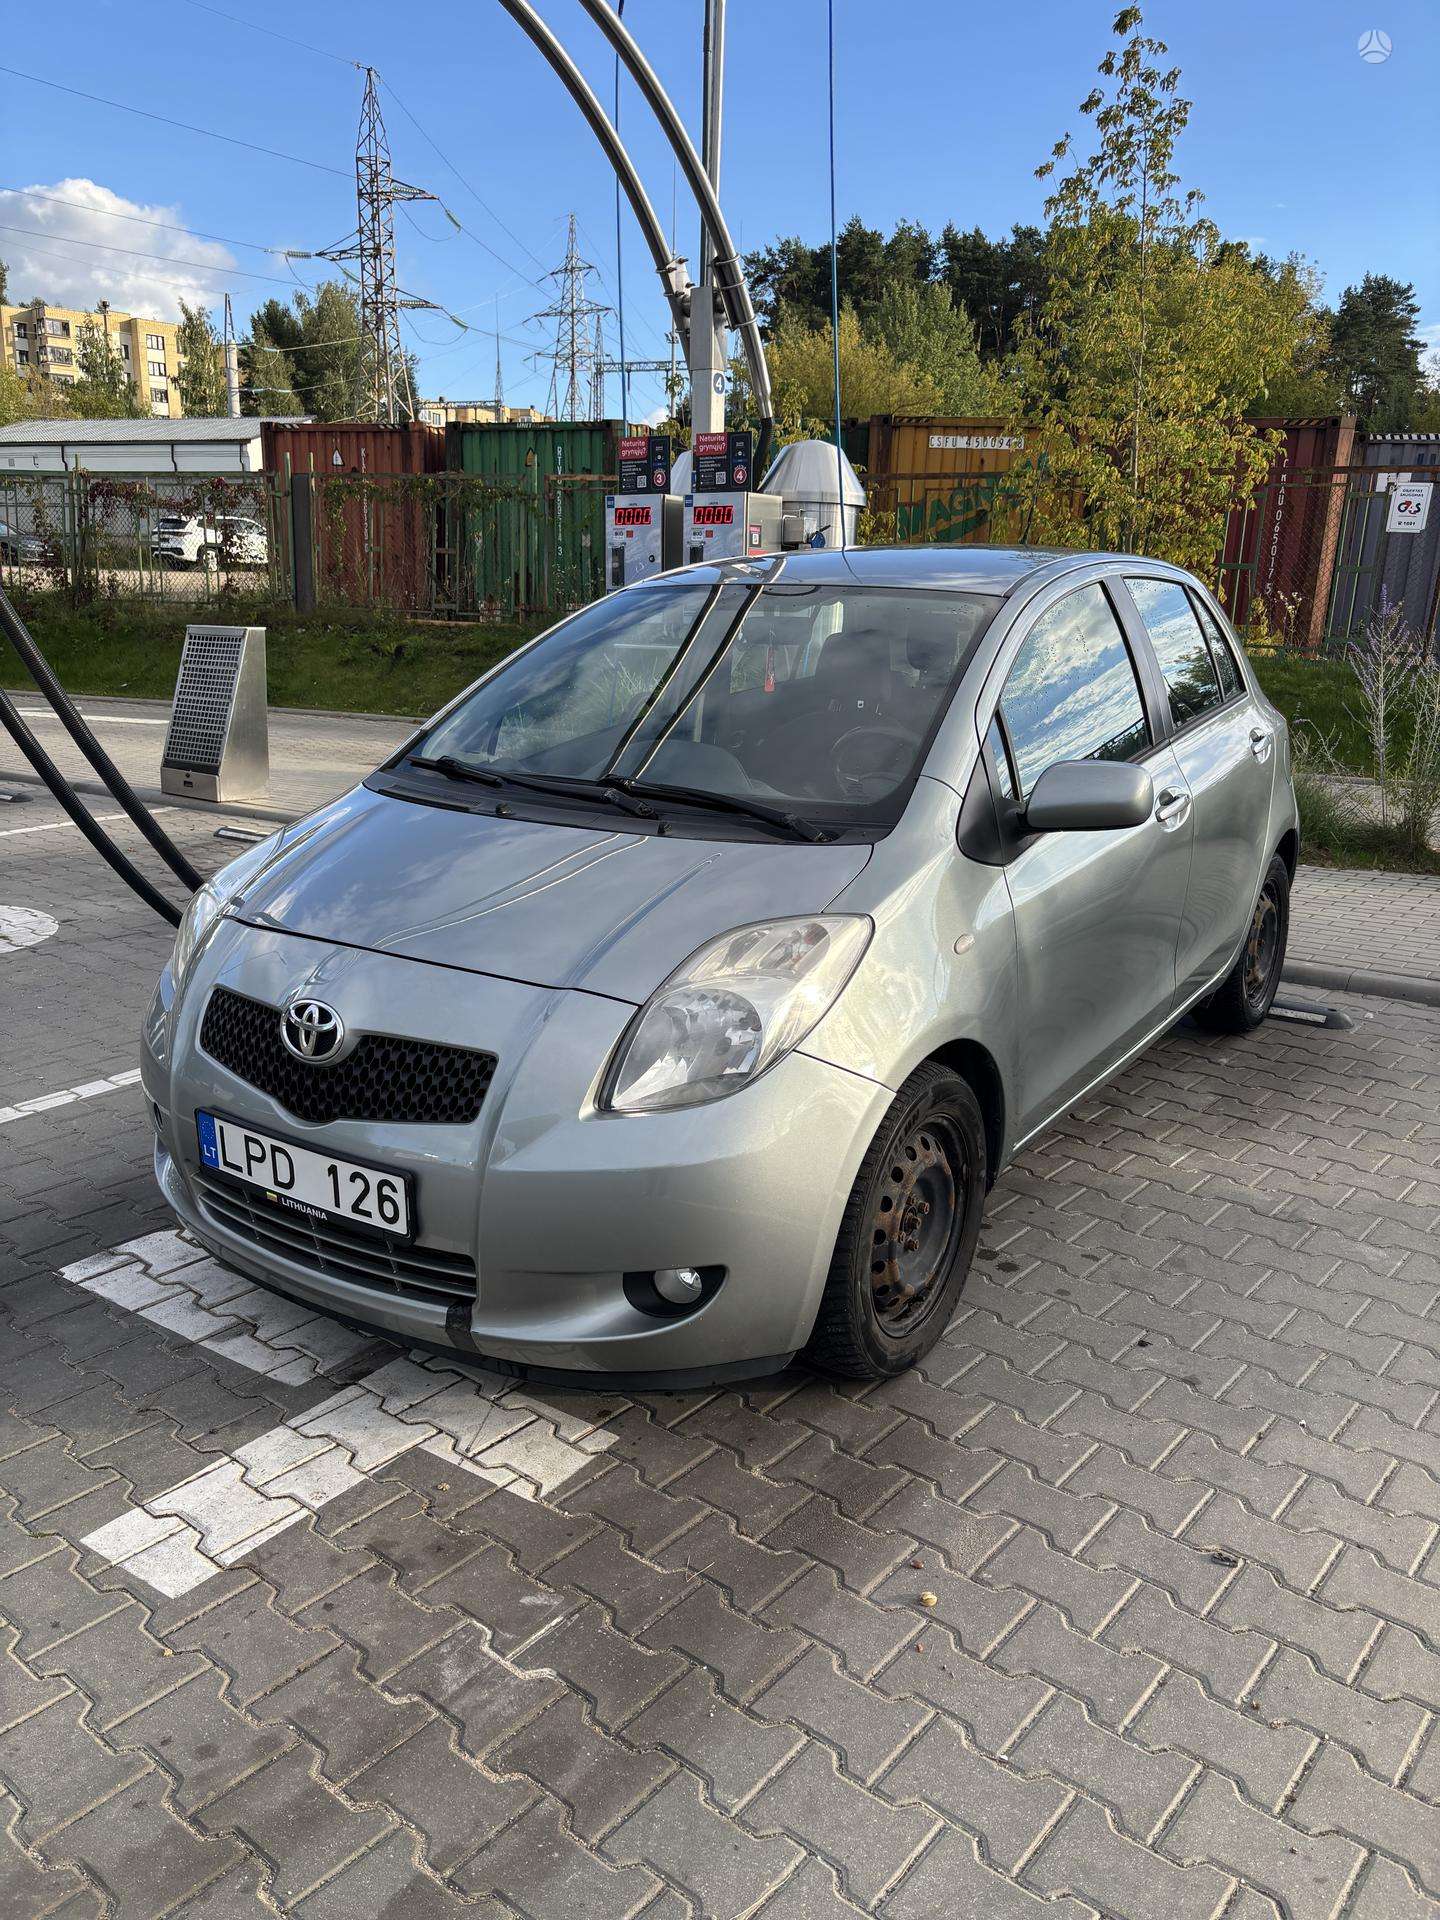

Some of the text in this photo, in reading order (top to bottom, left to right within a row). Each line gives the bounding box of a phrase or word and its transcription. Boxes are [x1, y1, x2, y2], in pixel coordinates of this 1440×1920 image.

[621, 439, 646, 448] Neturite
[699, 433, 725, 442] Neturite
[203, 1143, 217, 1160] LT
[218, 1124, 400, 1226] LPD 126
[281, 1196, 329, 1222] LITHUANIA
